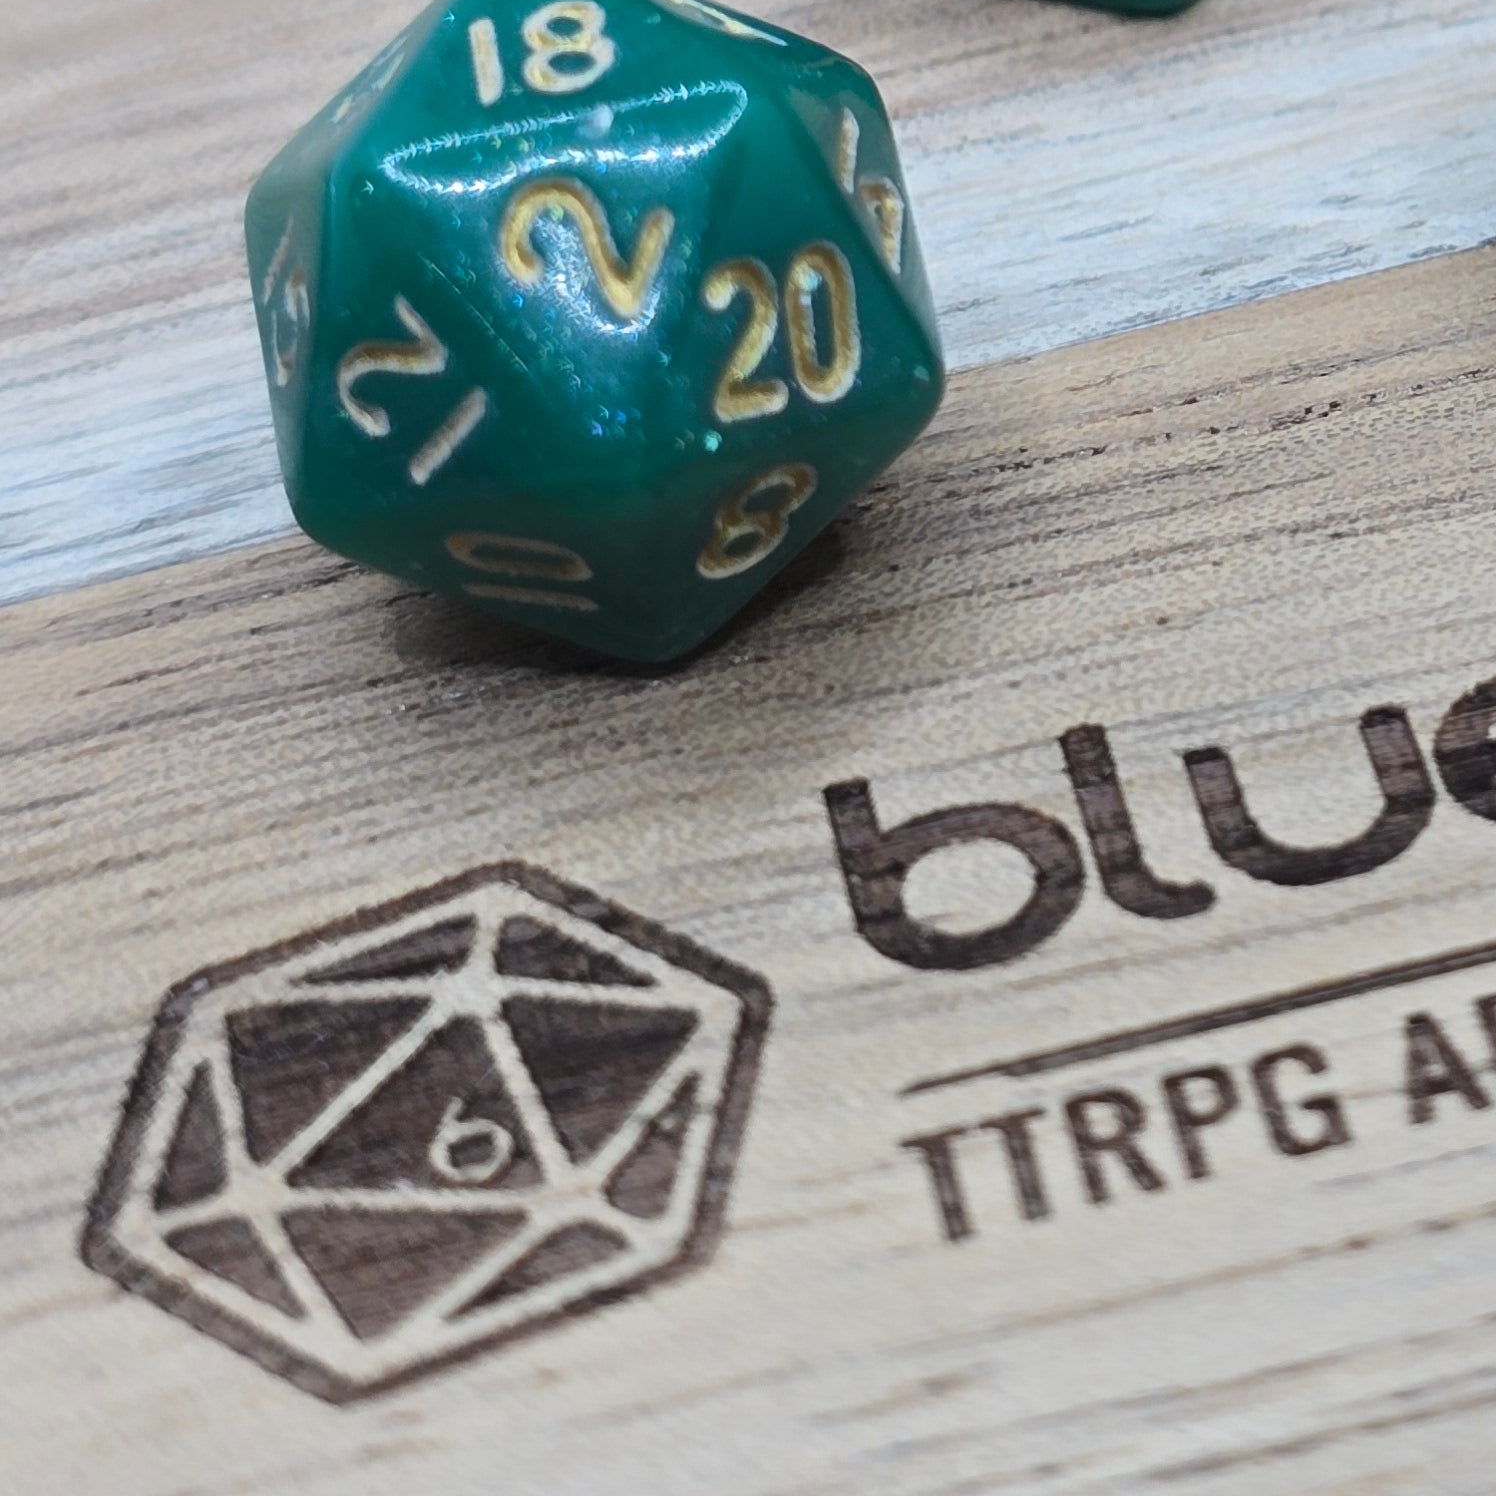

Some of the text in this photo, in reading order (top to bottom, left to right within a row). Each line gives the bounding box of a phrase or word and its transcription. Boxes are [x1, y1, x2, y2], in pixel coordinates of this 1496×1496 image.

[500, 177, 675, 319] 2
[336, 294, 487, 486] 12
[703, 239, 862, 424] 20
[696, 464, 818, 580] 8
[431, 1096, 513, 1186] 6
[899, 1042, 1354, 1244] TTRPG
